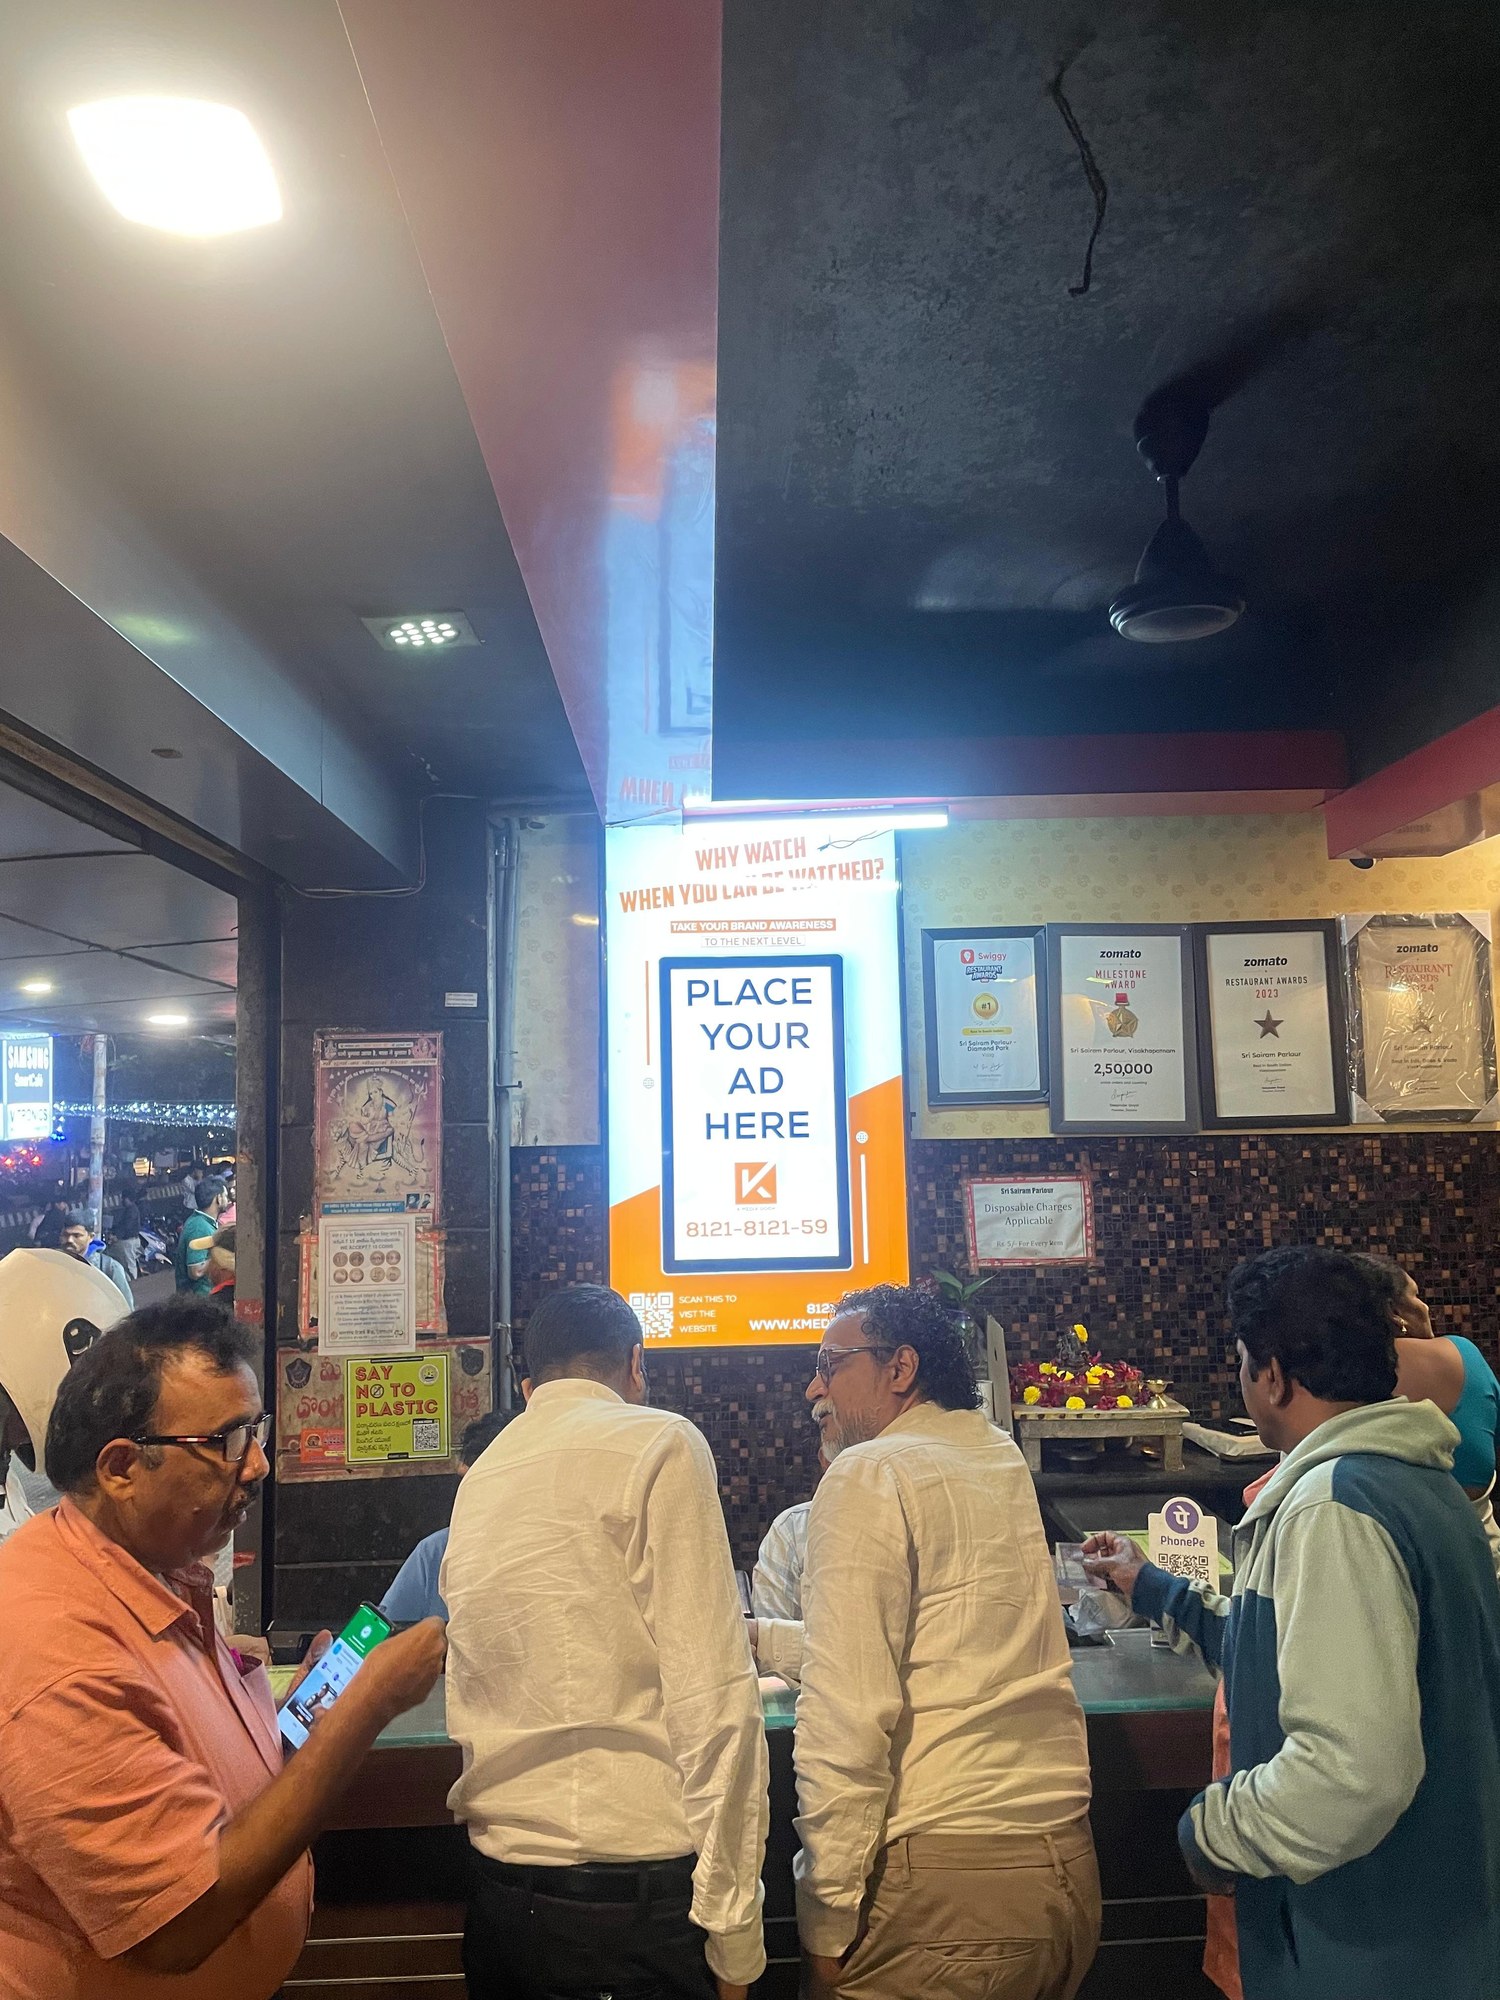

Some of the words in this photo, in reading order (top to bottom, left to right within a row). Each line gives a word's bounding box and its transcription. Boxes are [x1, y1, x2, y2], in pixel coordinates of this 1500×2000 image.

[695, 845, 739, 871] WHY
[744, 836, 807, 864] WATCH
[619, 885, 675, 913] WHEN
[678, 882, 717, 906] YOU
[671, 922, 696, 932] TAKE
[699, 921, 729, 931] YOUR
[731, 920, 767, 931] BRAND
[769, 919, 834, 930] AWARENESS
[704, 937, 718, 946] TO
[719, 937, 739, 946] THE
[741, 936, 769, 946] NEXT
[771, 936, 802, 945] LEVEL
[1100, 949, 1142, 958] zomato
[1396, 944, 1439, 953] zomato
[978, 952, 1007, 961] Swiggy
[1244, 956, 1288, 967] zomato
[1095, 969, 1147, 979] MILESTONE
[1225, 977, 1274, 987] RESTAURANT
[1276, 976, 1308, 985] AWARDS
[687, 978, 812, 1007] PLACE
[1255, 989, 1279, 998] 2023
[981, 1002, 991, 1010] #1
[700, 1022, 810, 1050] YOUR
[8, 1045, 50, 1070] SAMSUNG
[1241, 1051, 1251, 1059] Sri
[1094, 1063, 1153, 1077] 2,50,000
[728, 1066, 784, 1095] AD
[705, 1111, 810, 1140] HERE
[1000, 1187, 1010, 1195] Sri
[984, 1202, 1034, 1215] Disposable
[1036, 1202, 1073, 1213] Charges
[686, 1218, 828, 1238] 8121-8121-59
[1004, 1216, 1054, 1228] Applicable
[1030, 1240, 1048, 1248] Every
[679, 1295, 703, 1304] SCAN
[704, 1295, 724, 1303] THIS
[725, 1295, 737, 1303] TO
[679, 1310, 697, 1318] VIST
[698, 1309, 716, 1318] THE
[806, 1303, 834, 1314] 812
[679, 1324, 718, 1333] WEBSITE
[749, 1317, 835, 1331] WWW.KMED
[355, 1365, 393, 1381] SAY
[390, 1382, 416, 1397] TO
[356, 1399, 438, 1417] PLASTIC
[1173, 1505, 1191, 1529] पे
[1160, 1535, 1205, 1547] PhonePe
